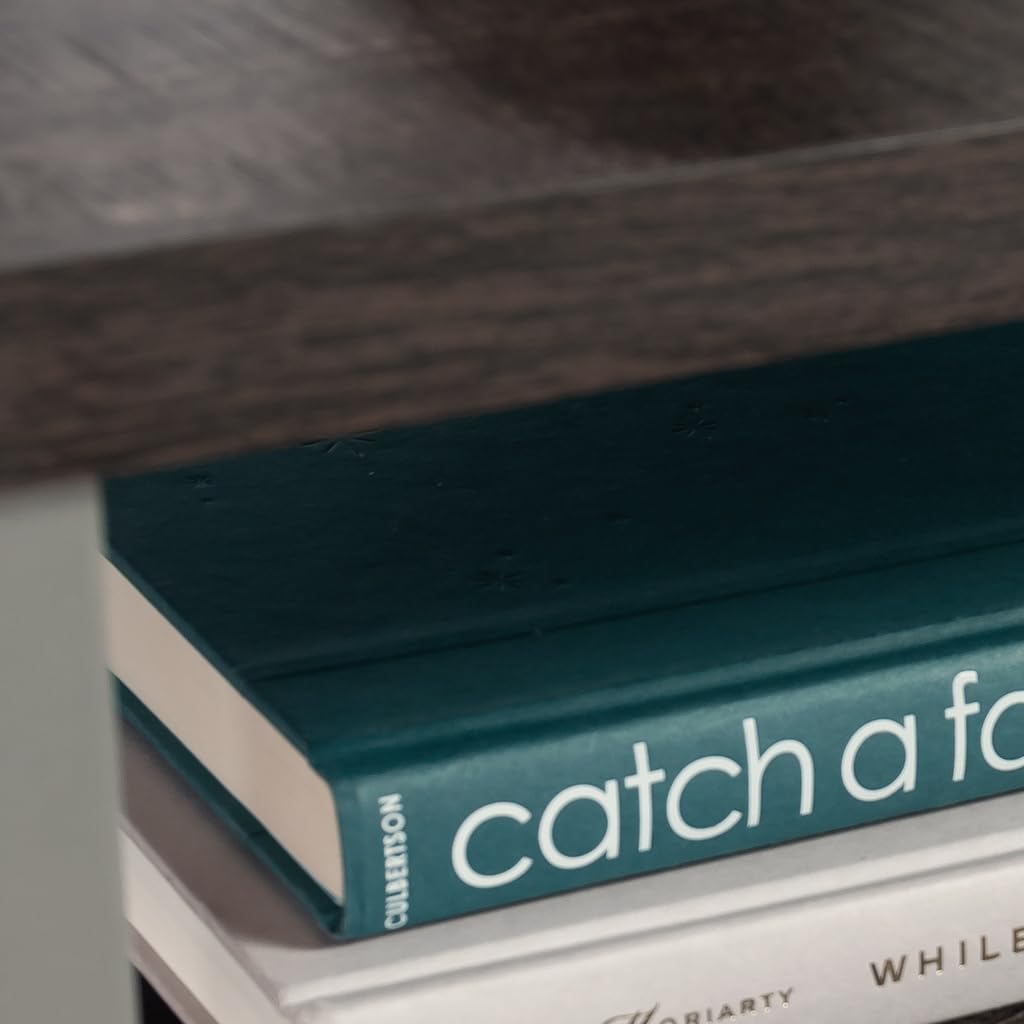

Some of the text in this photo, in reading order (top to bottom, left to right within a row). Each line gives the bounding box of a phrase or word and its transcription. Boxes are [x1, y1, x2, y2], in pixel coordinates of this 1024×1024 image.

[378, 792, 409, 930] CULBERTSON
[451, 717, 815, 888] catch
[840, 714, 918, 801] a
